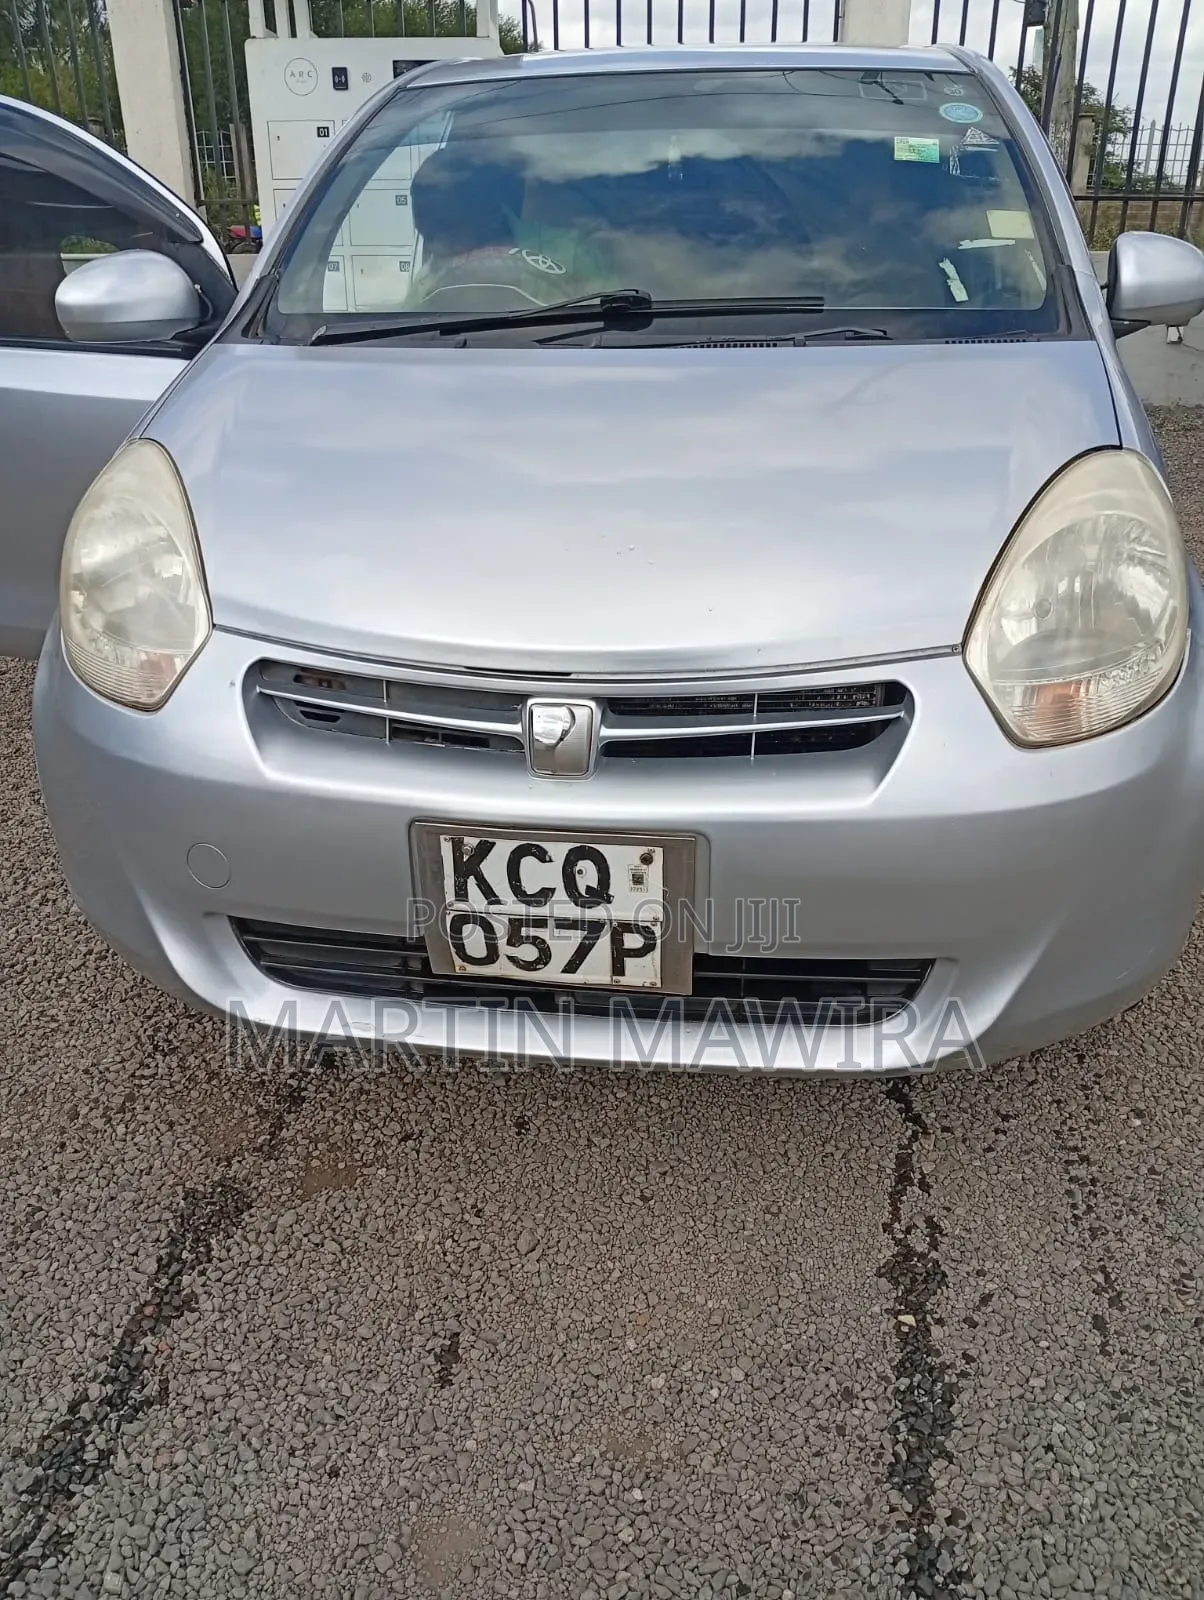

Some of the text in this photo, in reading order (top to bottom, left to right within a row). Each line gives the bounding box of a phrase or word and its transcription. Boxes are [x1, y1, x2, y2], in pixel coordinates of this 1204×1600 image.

[319, 127, 328, 137] 01
[451, 836, 615, 909] KCQ
[448, 912, 658, 977] 057P
